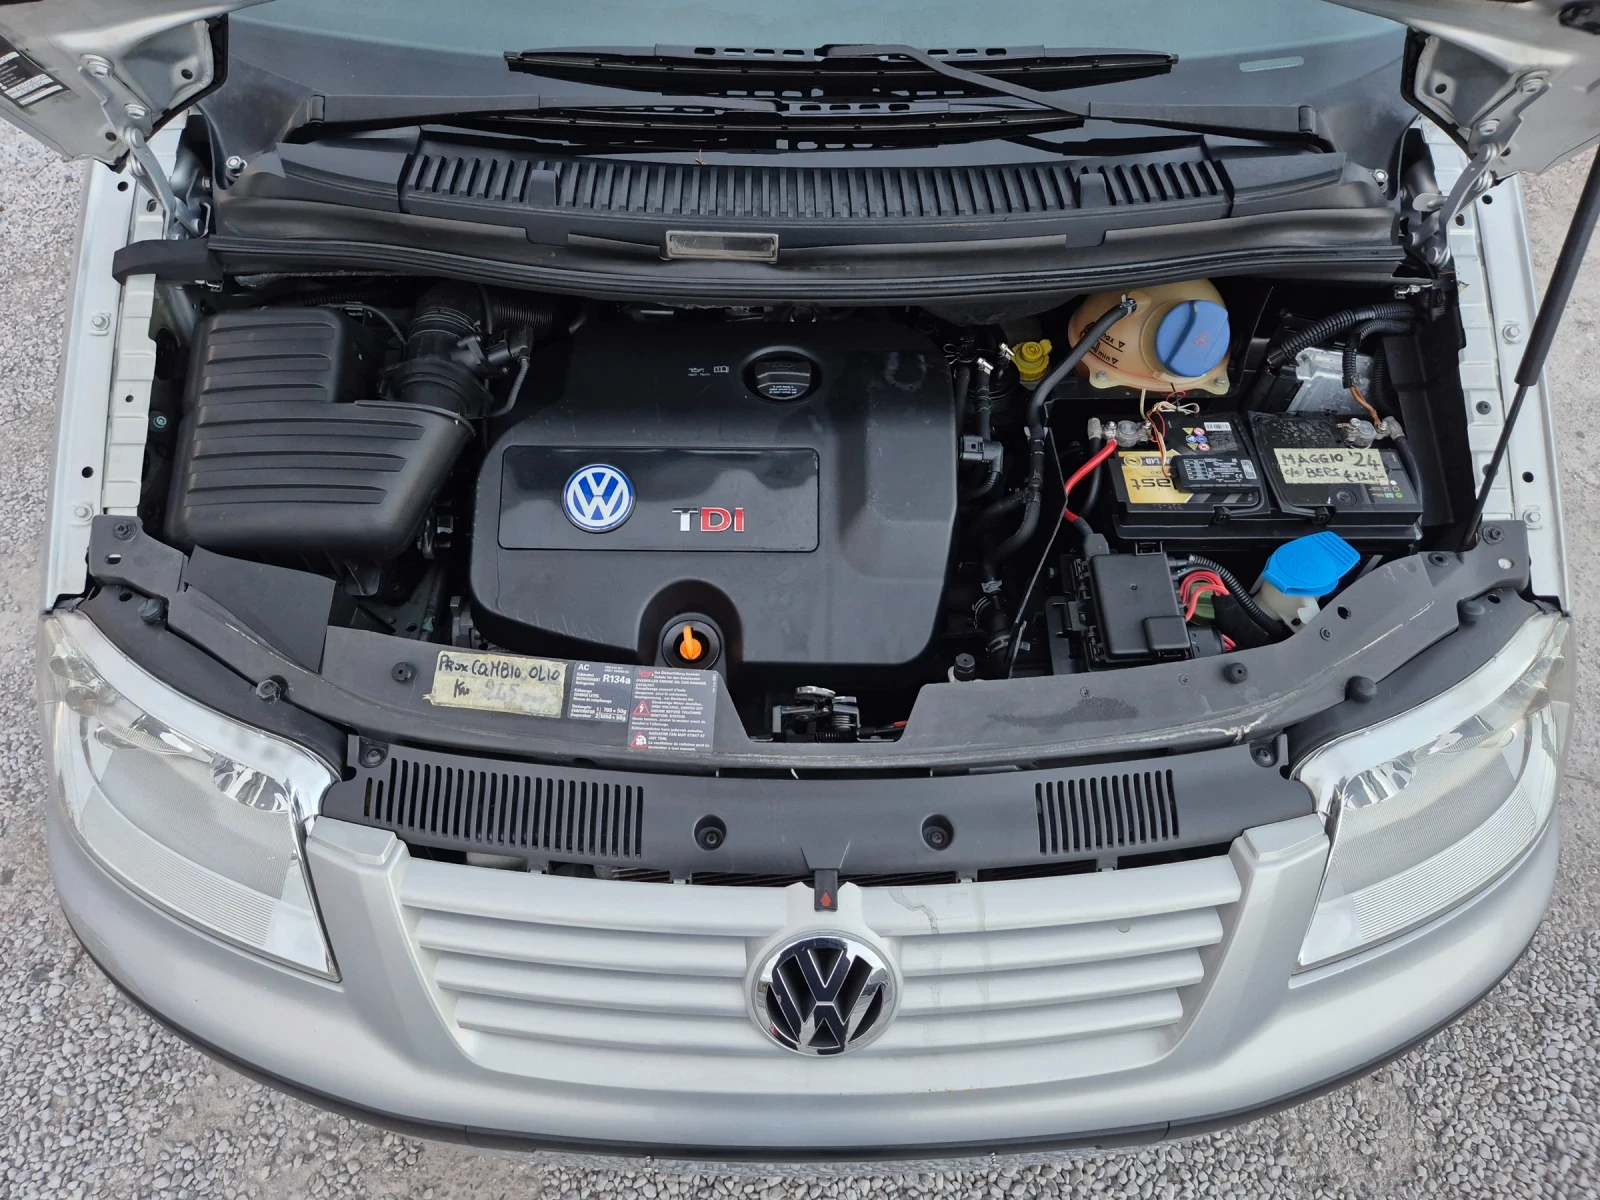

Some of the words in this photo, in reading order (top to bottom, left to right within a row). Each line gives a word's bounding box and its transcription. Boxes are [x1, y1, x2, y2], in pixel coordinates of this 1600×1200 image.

[1097, 350, 1111, 362] min
[1281, 453, 1344, 467] MAGGIO
[672, 507, 744, 532] TDI
[528, 664, 560, 681] OLIO
[602, 674, 630, 684] R134a
